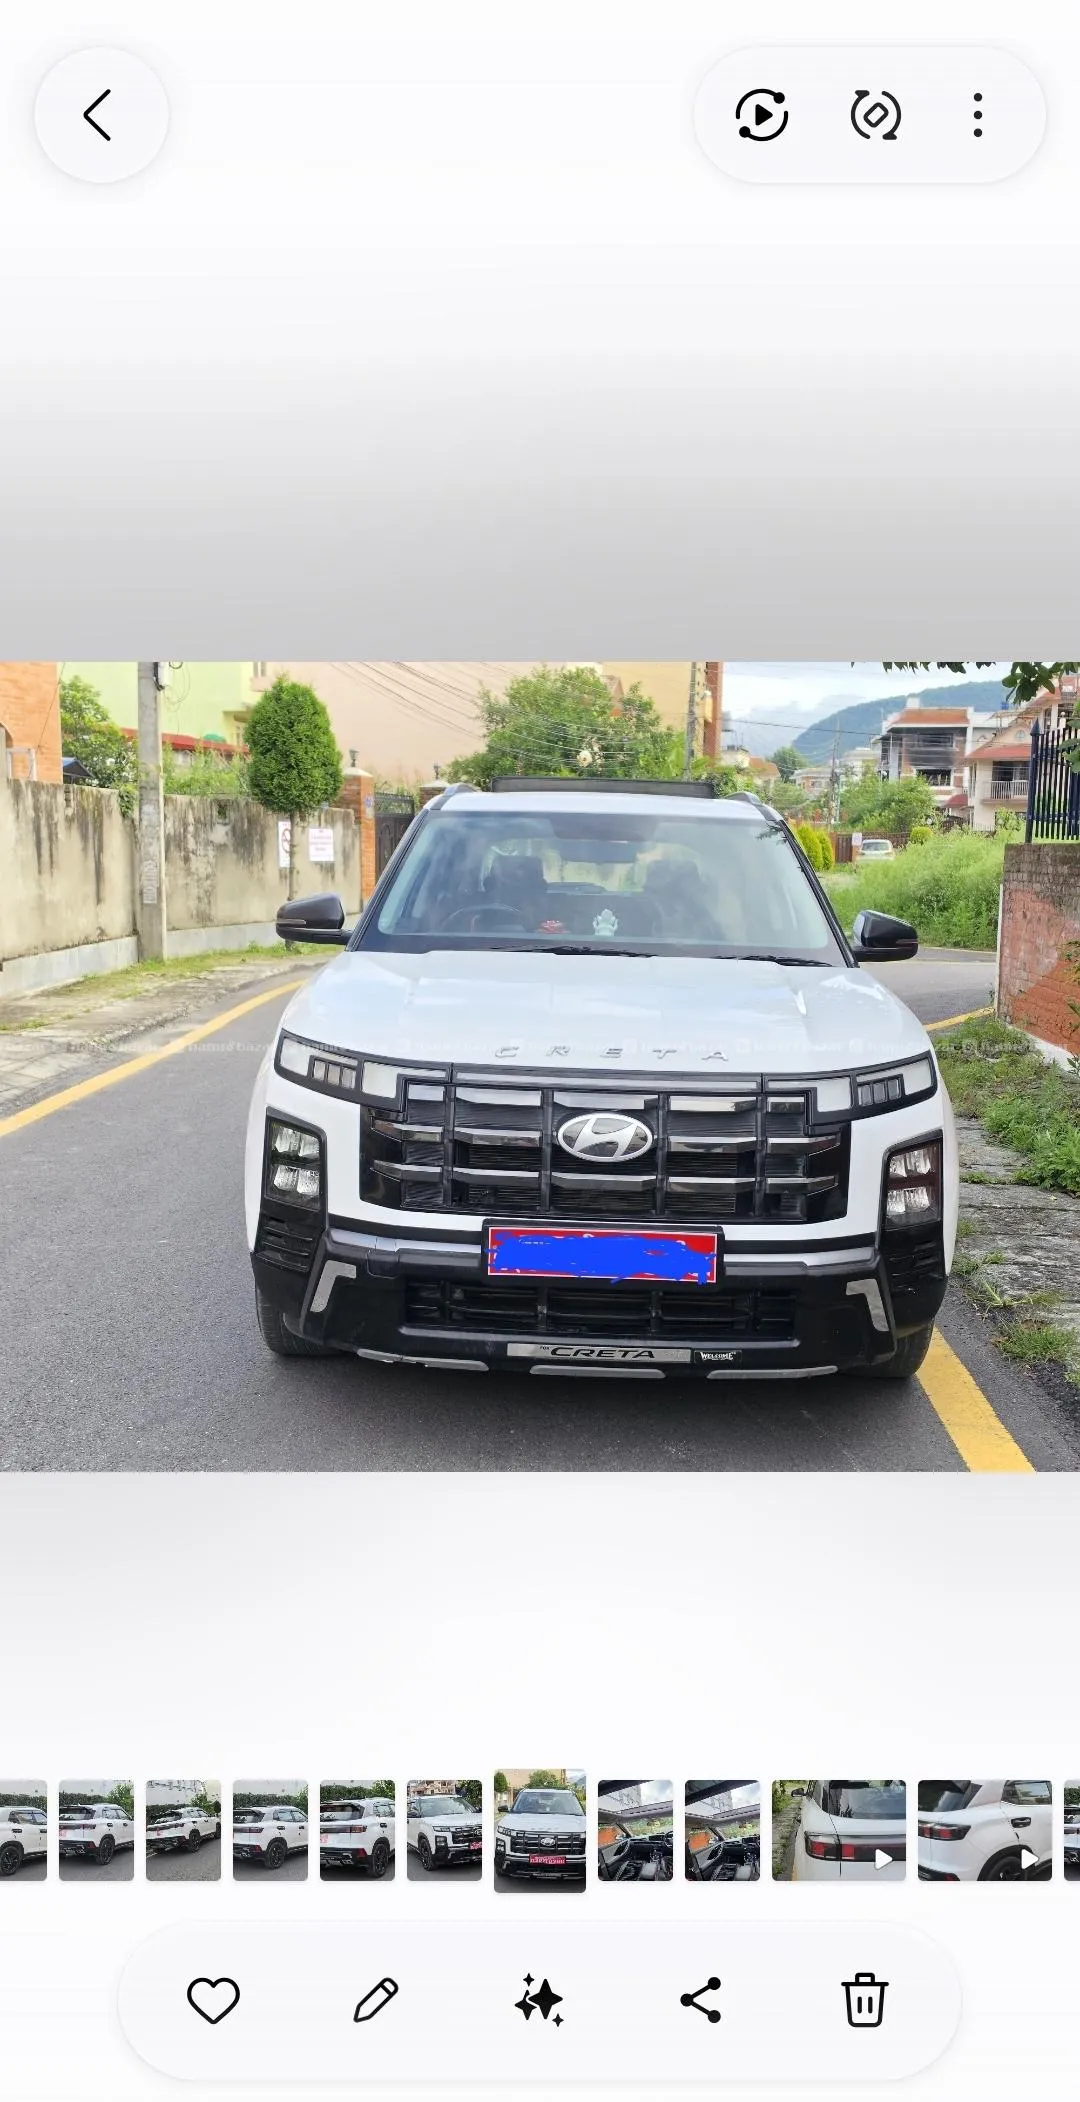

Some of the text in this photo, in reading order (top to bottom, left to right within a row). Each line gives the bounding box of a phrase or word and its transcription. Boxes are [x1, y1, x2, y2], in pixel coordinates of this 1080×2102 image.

[494, 1045, 730, 1062] CRETA
[550, 1346, 655, 1359] CRETA
[699, 1351, 736, 1362] WELCOME
